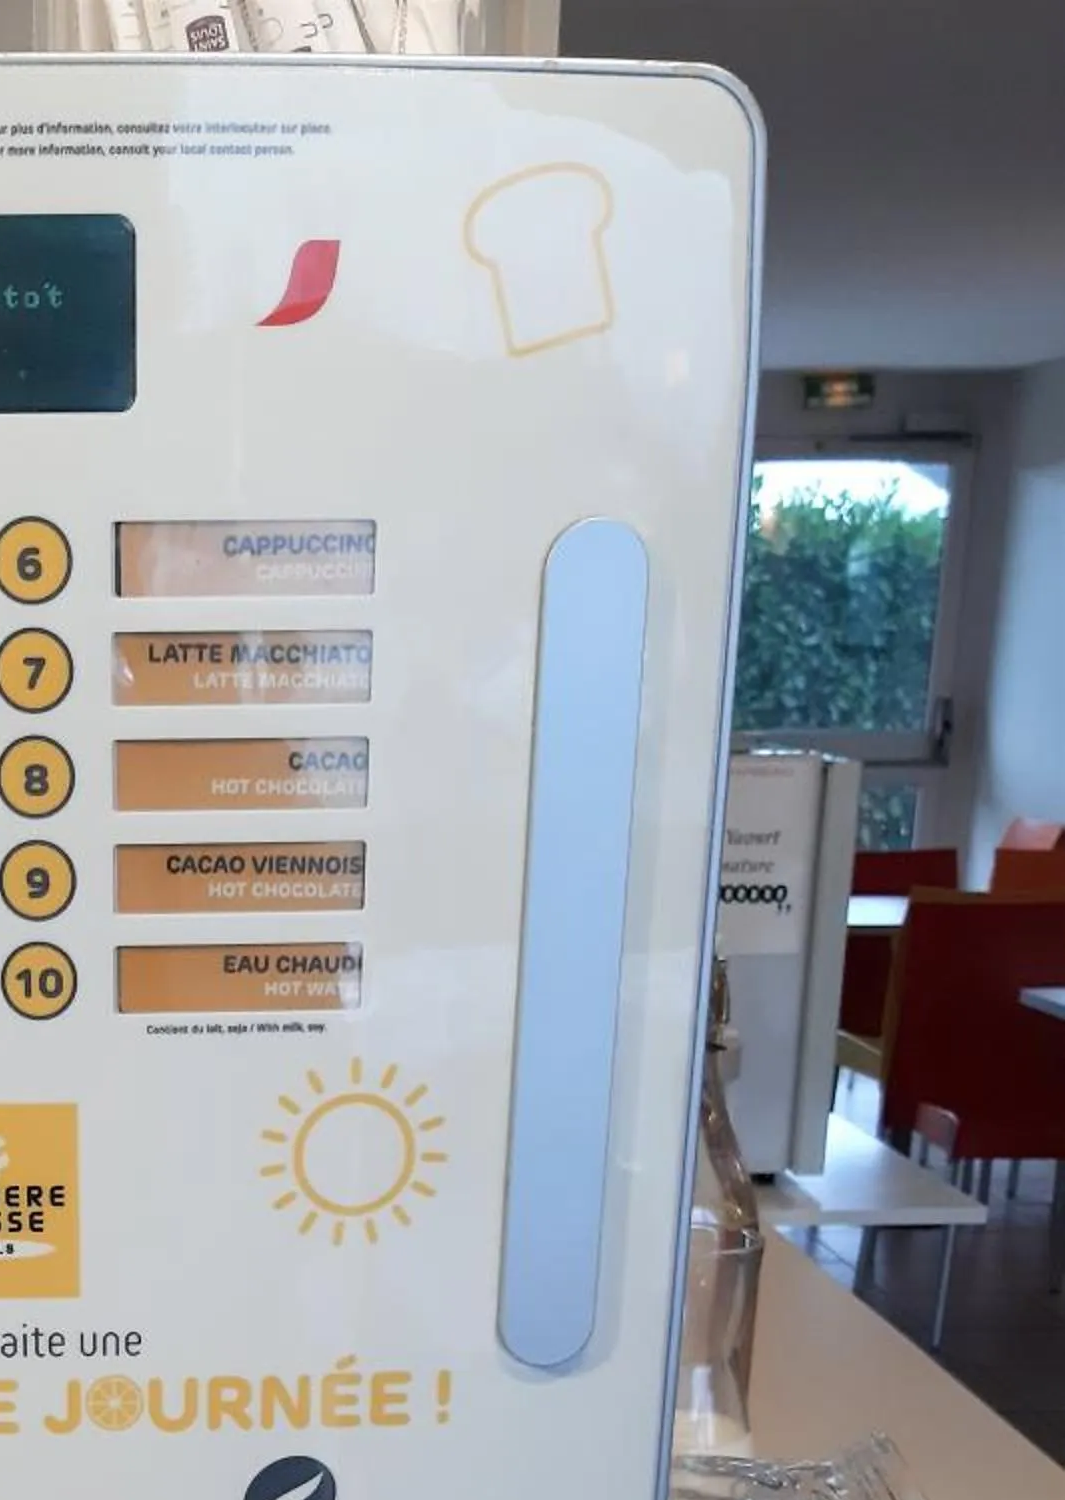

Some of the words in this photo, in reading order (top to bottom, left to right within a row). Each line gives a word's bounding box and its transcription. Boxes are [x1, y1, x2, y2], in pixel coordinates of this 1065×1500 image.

[11, 124, 33, 137] plus
[117, 123, 169, 134] consultez
[173, 123, 201, 134] votre
[281, 125, 297, 134] sur
[7, 147, 35, 156] more
[109, 143, 149, 155] consult
[152, 145, 179, 158] your
[181, 143, 207, 155] local
[210, 143, 252, 155] contact
[254, 145, 293, 158] person.
[17, 547, 43, 581] 6
[148, 644, 222, 664] LATTE
[231, 644, 370, 664] MACCHIATO
[22, 658, 47, 690] 7
[194, 673, 254, 690] LATTE
[24, 764, 49, 796] 8
[212, 779, 249, 794] HOT
[166, 856, 246, 875] CACAO
[252, 855, 363, 875] VIENNOIS
[25, 867, 50, 898] 9
[208, 882, 246, 898] HOT
[251, 880, 363, 898] CHOCOLATE
[223, 955, 268, 974] EAU
[15, 968, 63, 999] 10
[264, 982, 301, 997] HOT
[81, 1330, 142, 1356] une
[44, 1357, 412, 1435] JOURNÉE
[435, 1369, 453, 1424] !
